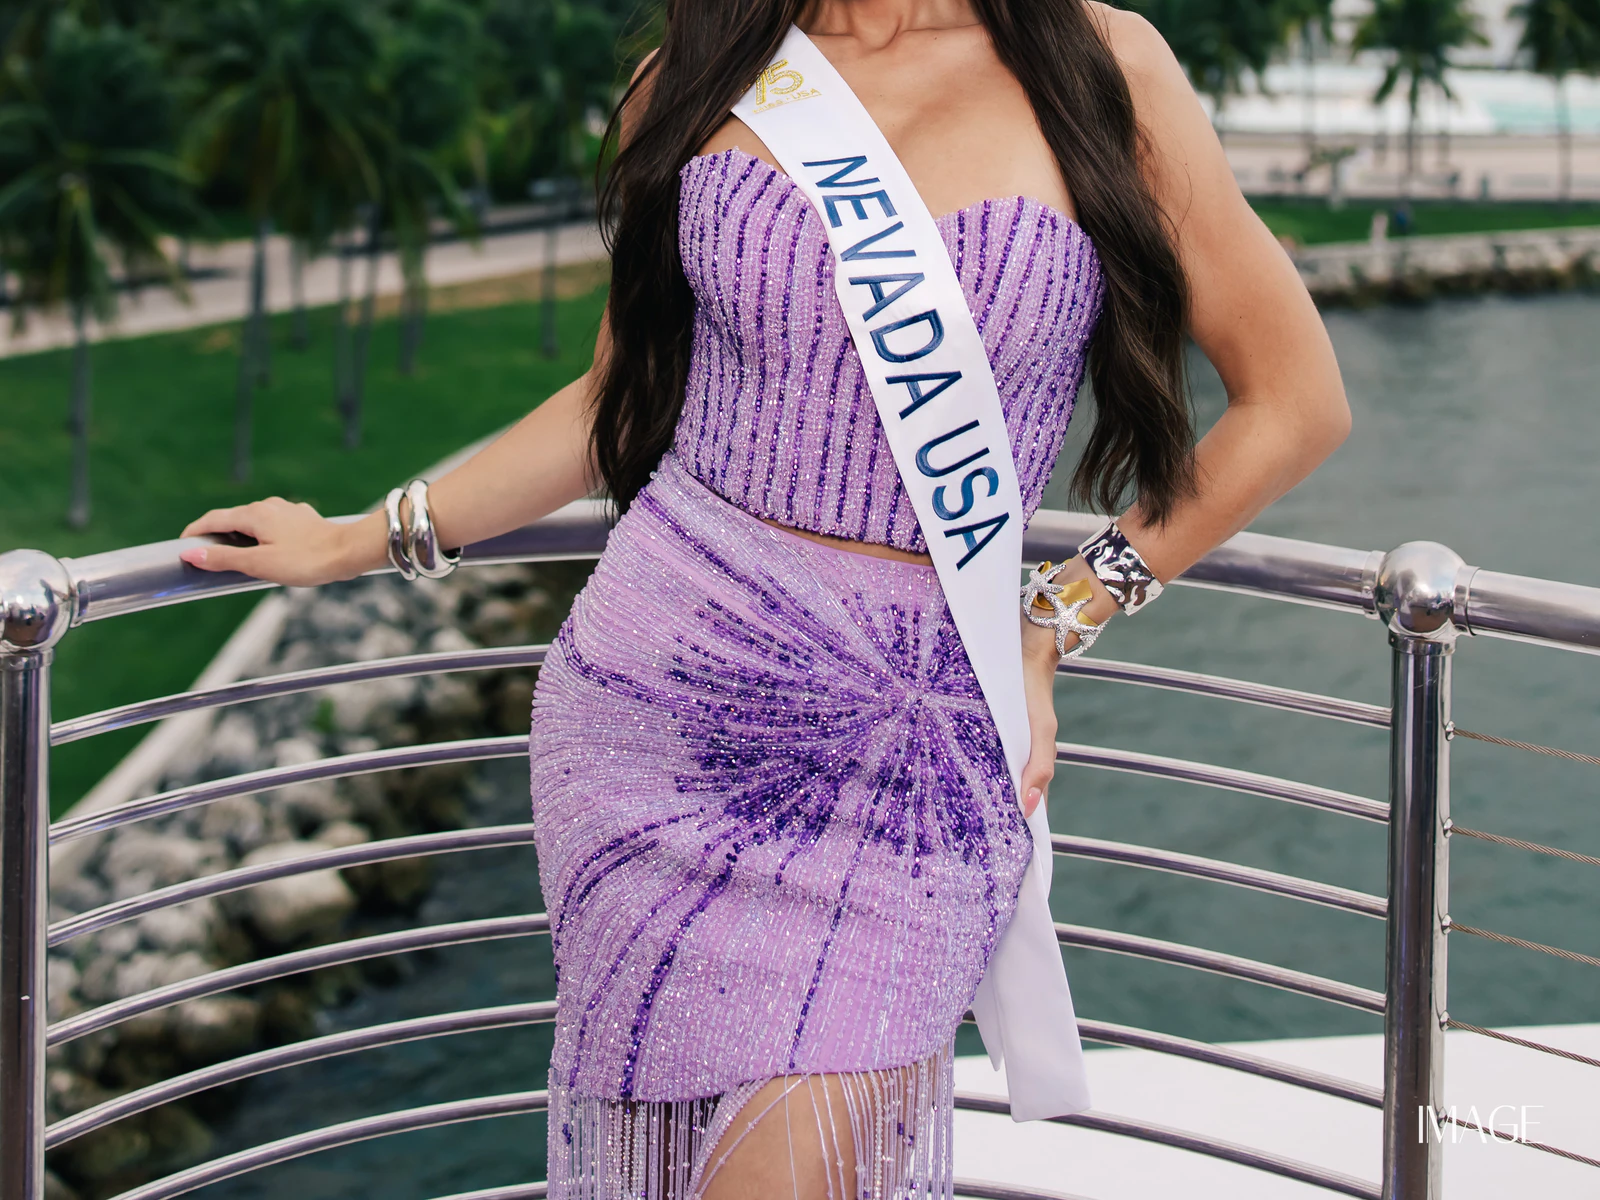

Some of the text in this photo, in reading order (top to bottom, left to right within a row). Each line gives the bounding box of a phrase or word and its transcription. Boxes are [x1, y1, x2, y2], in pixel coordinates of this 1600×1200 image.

[790, 88, 821, 101] USA
[802, 155, 1010, 572] NEVADA USA
